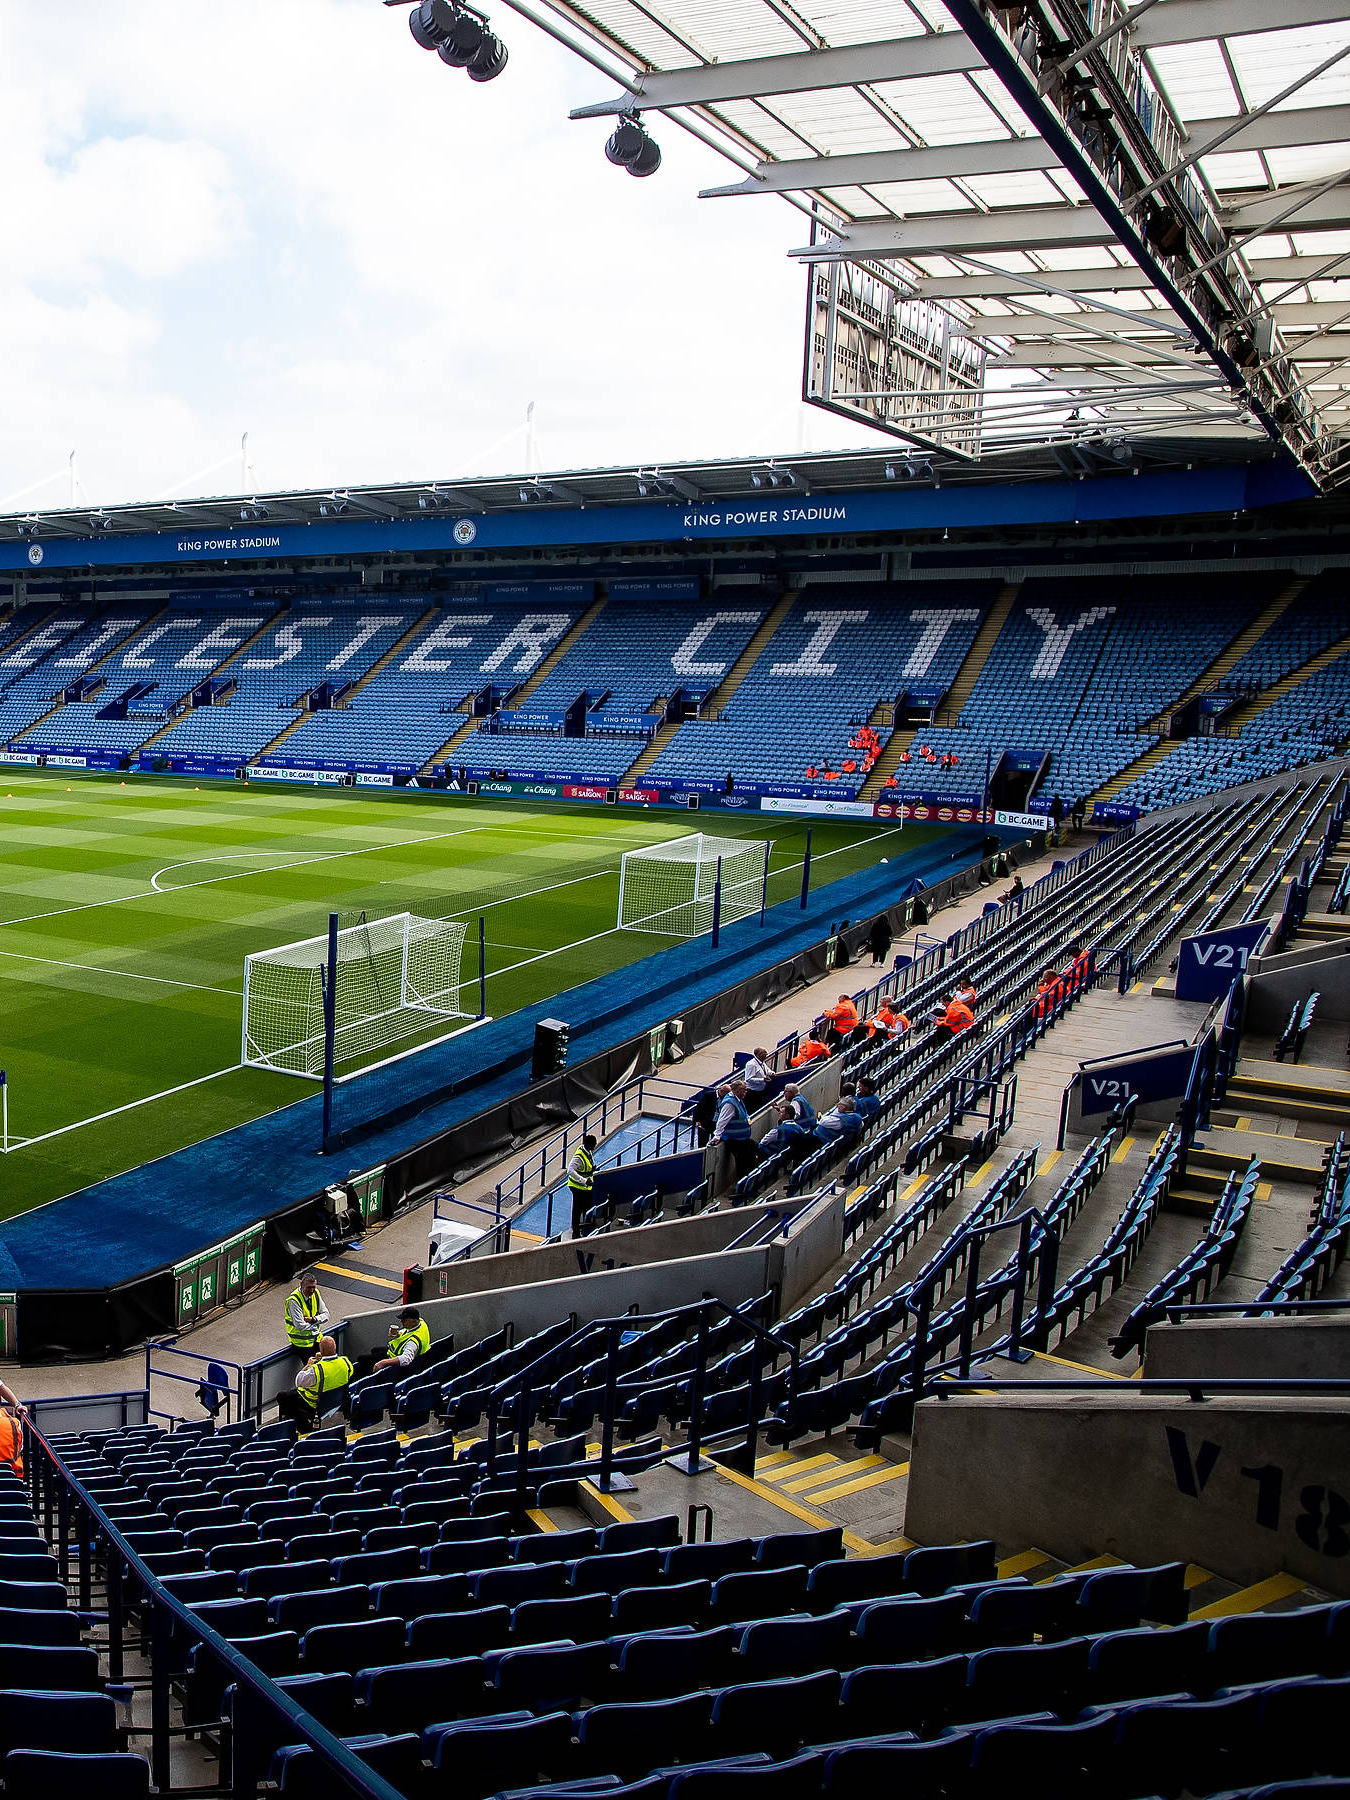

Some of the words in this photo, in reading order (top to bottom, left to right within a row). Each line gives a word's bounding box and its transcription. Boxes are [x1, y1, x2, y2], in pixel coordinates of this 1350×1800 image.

[683, 515, 721, 527] KING
[725, 511, 778, 525] POWER
[782, 507, 846, 522] STADIUM
[177, 541, 202, 551] KING
[204, 539, 237, 550] POWER
[240, 537, 280, 548] STADIUM
[670, 606, 1116, 678] CITY
[364, 776, 391, 784] BC.GAME
[490, 784, 512, 794] Chang
[534, 785, 557, 796] Chang
[1009, 816, 1045, 827] BC.GAME
[1192, 942, 1248, 969] V21
[1091, 1079, 1131, 1097] V21
[576, 1249, 633, 1274] V1
[1165, 1425, 1350, 1558] V18
